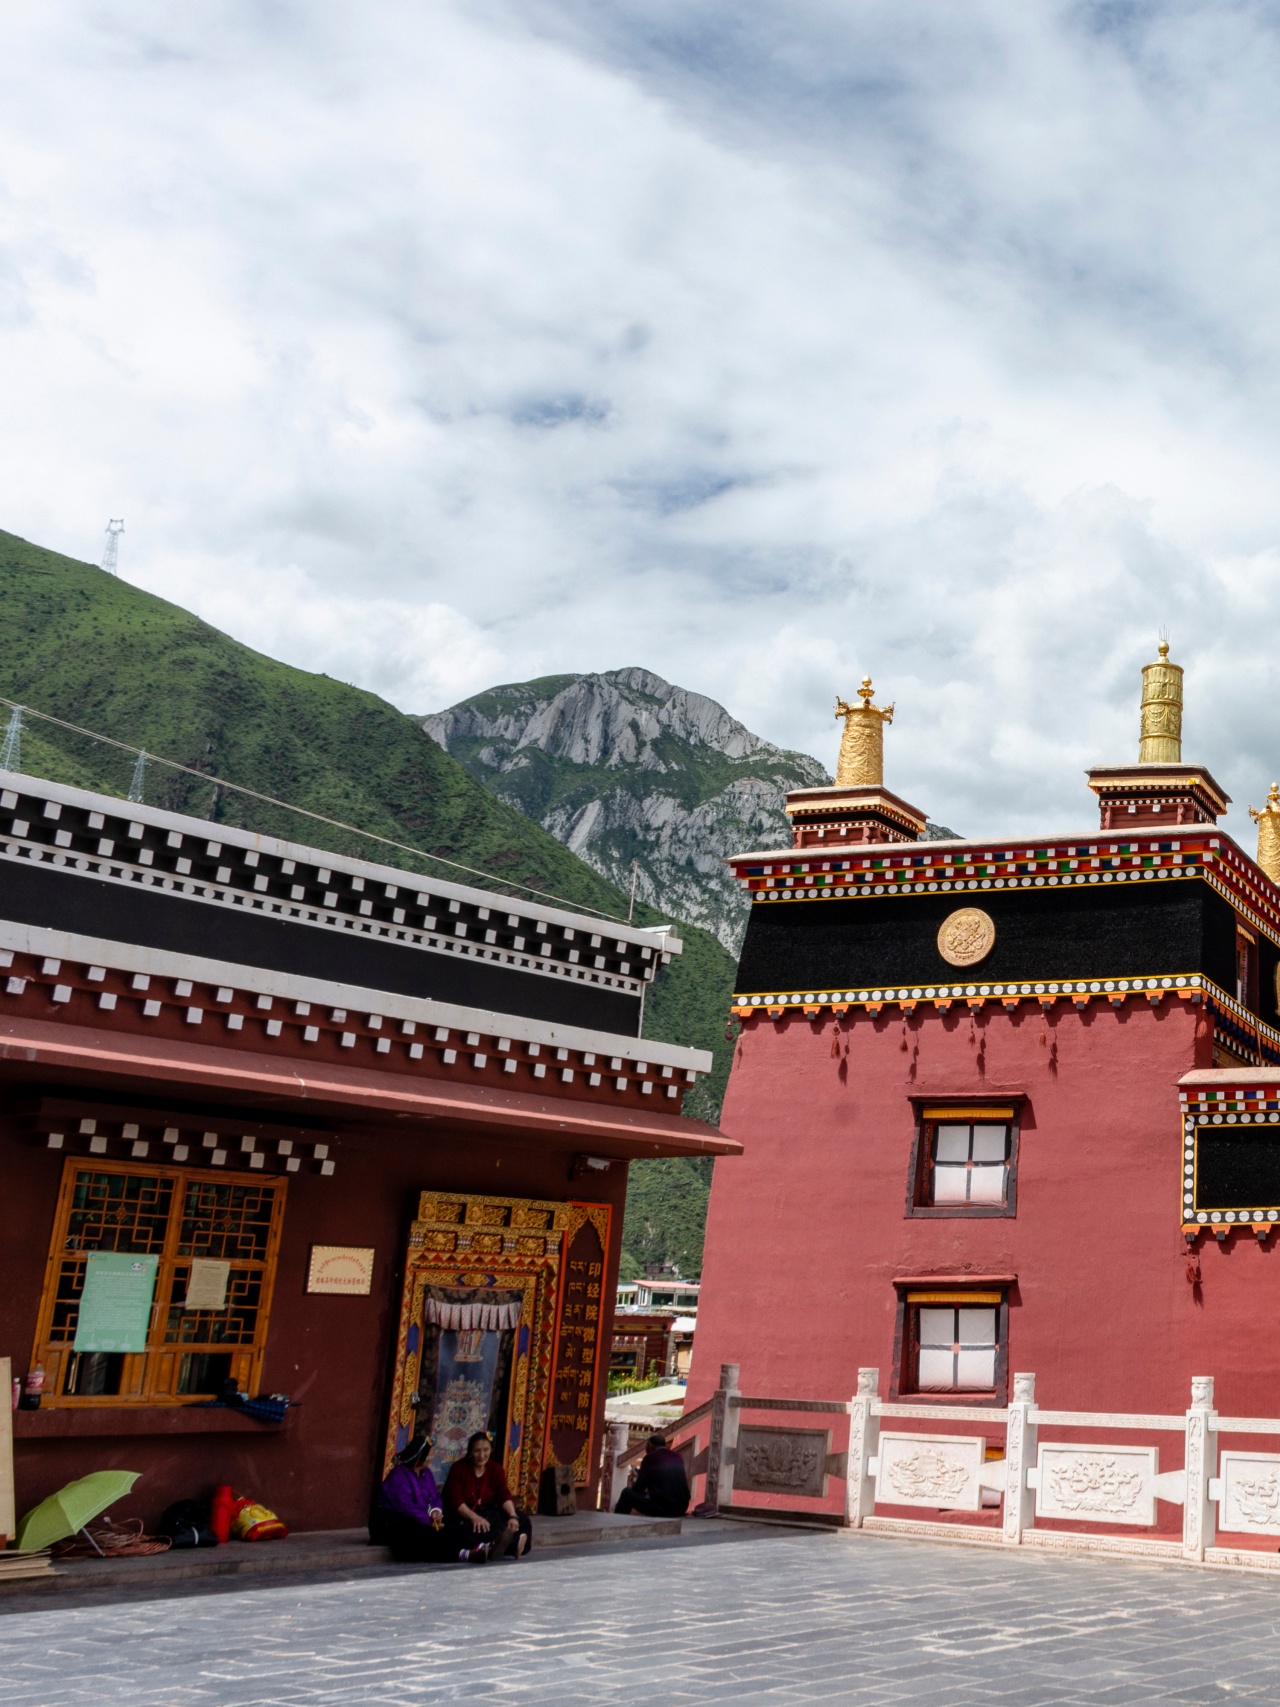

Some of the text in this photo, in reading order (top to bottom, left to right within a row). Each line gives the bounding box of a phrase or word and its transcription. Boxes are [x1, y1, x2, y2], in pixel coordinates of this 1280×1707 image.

[576, 1261, 602, 1431] 印经院微型消防站
